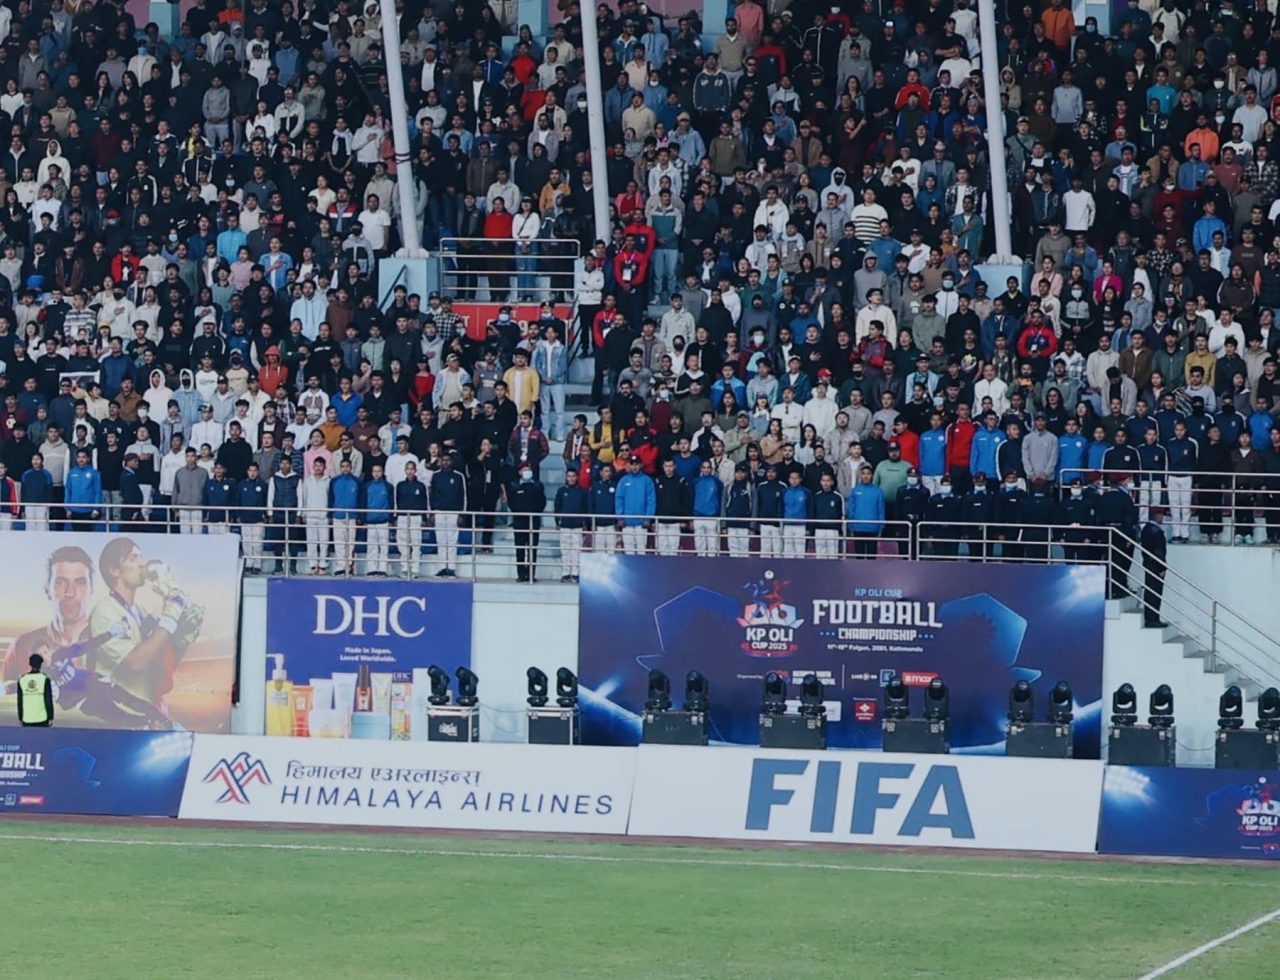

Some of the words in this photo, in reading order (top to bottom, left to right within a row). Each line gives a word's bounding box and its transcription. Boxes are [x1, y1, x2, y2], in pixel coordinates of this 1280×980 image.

[855, 588, 867, 597] KP
[868, 588, 882, 597] OLI
[884, 589, 903, 598] CUP
[312, 594, 426, 638] DHC
[812, 599, 943, 628] FOOTBALL
[746, 628, 766, 641] KP
[769, 628, 793, 642] OLI
[838, 628, 917, 641] CHAMPIONSHIP
[768, 642, 787, 650] 2025
[393, 671, 411, 680] DHC
[286, 760, 363, 780] हिमालय
[281, 786, 442, 809] HIMALAYA
[460, 791, 613, 815] AIRLINES
[744, 758, 976, 839] FIFA
[1242, 815, 1257, 825] KP
[1259, 815, 1278, 826] OLI
